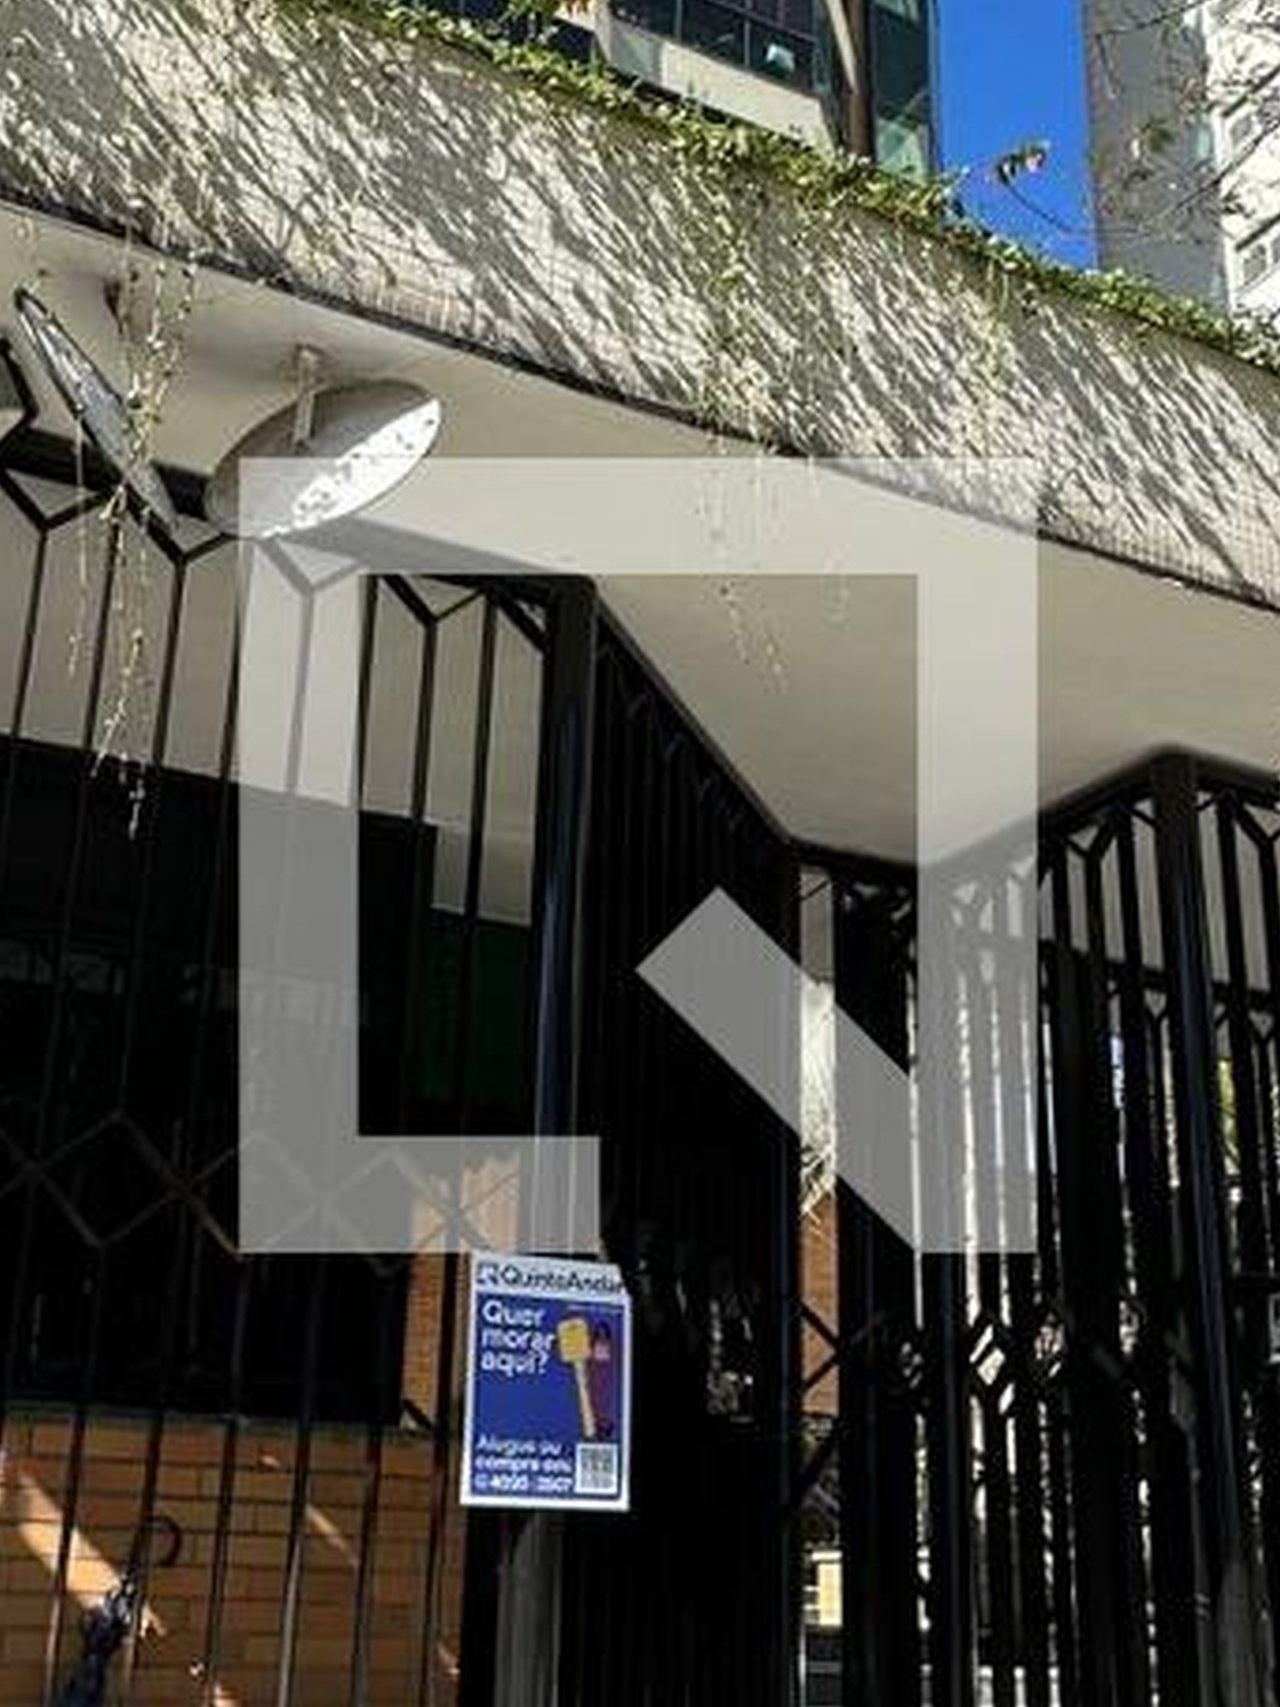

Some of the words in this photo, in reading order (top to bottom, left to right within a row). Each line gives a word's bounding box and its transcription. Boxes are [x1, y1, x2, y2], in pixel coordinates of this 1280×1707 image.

[482, 1299, 545, 1326] Quer
[482, 1327, 555, 1351] morar
[480, 1349, 550, 1377] aqui?
